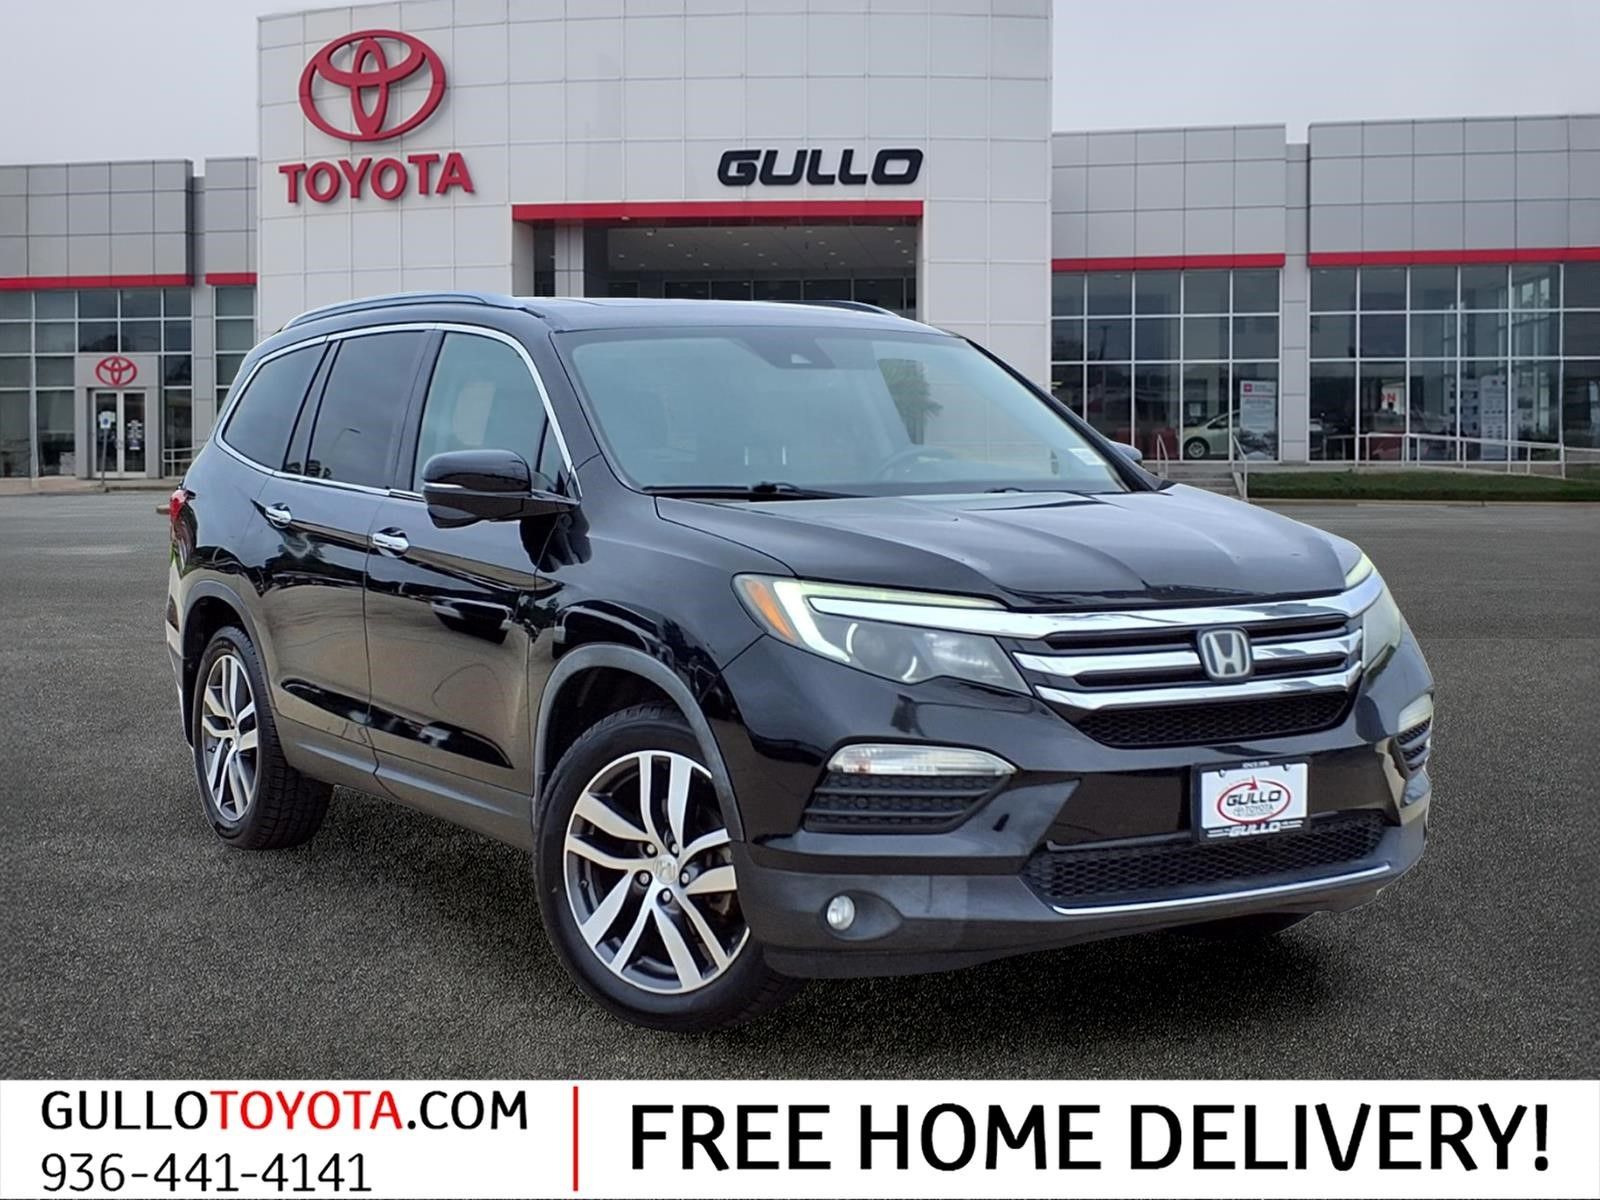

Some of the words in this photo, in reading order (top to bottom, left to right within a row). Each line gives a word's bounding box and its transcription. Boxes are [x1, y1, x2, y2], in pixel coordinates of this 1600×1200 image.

[279, 152, 475, 204] TOYOTA
[718, 149, 924, 187] GULLO
[1227, 790, 1282, 806] GULLO
[1229, 821, 1281, 838] GULLO
